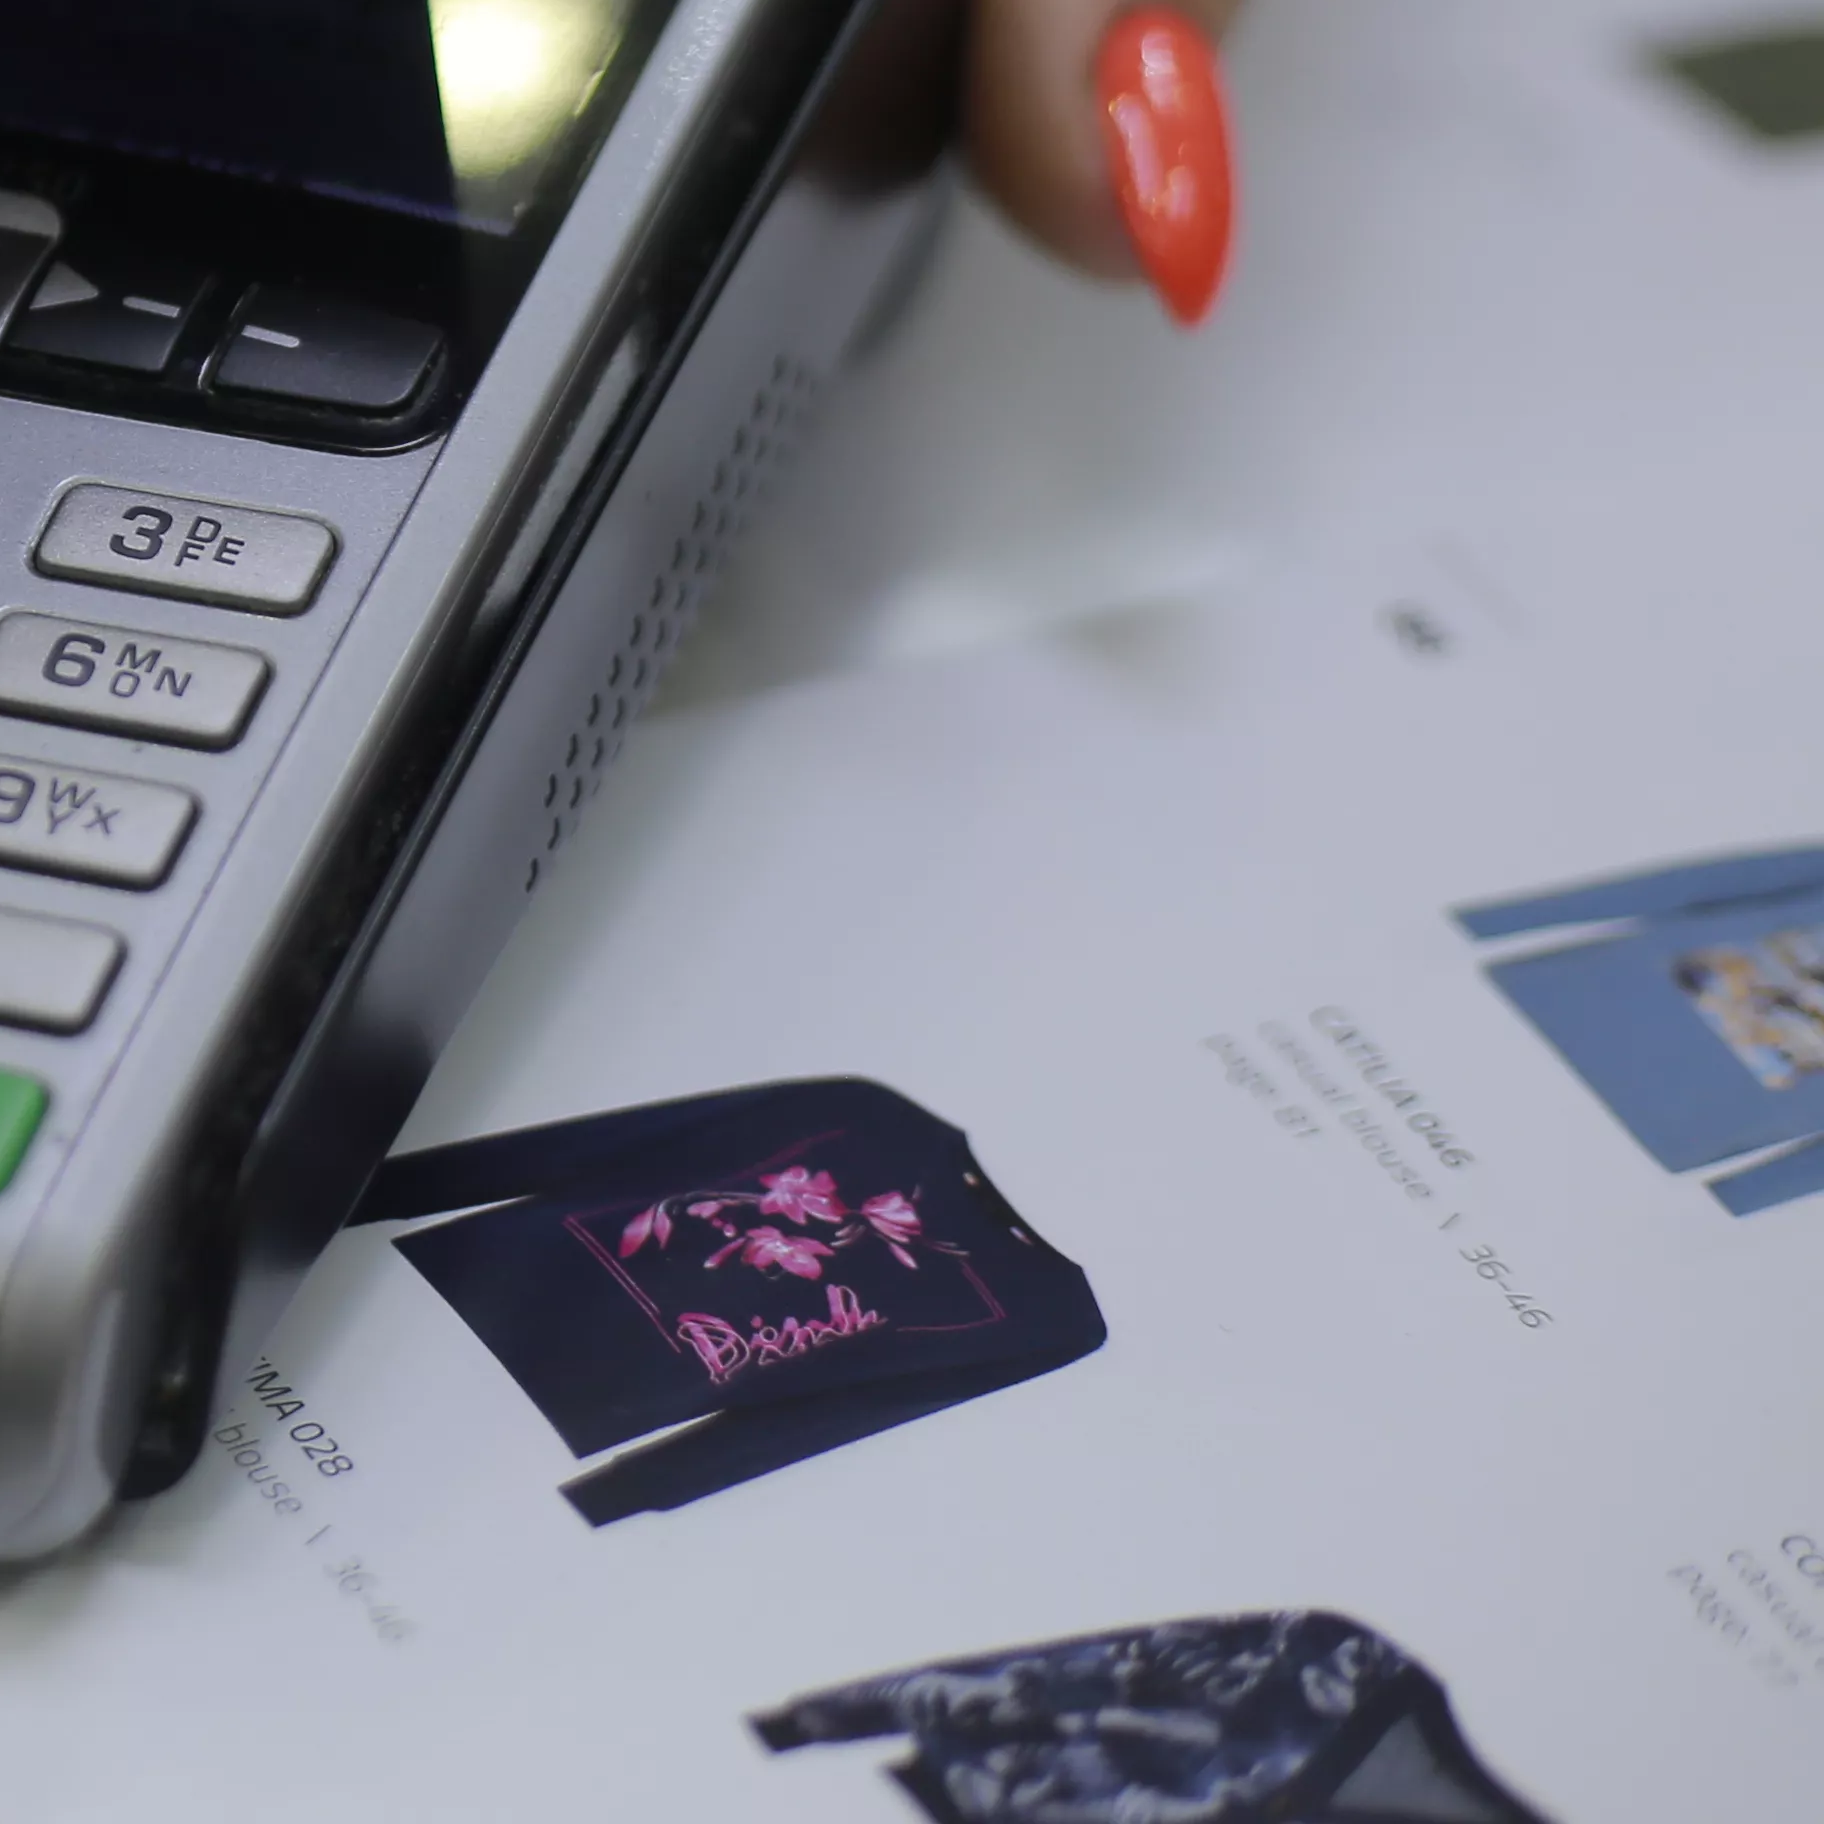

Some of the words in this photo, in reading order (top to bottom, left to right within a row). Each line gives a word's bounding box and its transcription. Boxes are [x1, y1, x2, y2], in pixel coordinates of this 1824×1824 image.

[108, 504, 175, 562] 3
[41, 631, 107, 688] 6
[1458, 1243, 1554, 1329] 36-46
[213, 1422, 303, 1516] blouse
[289, 1421, 354, 1478] 028
